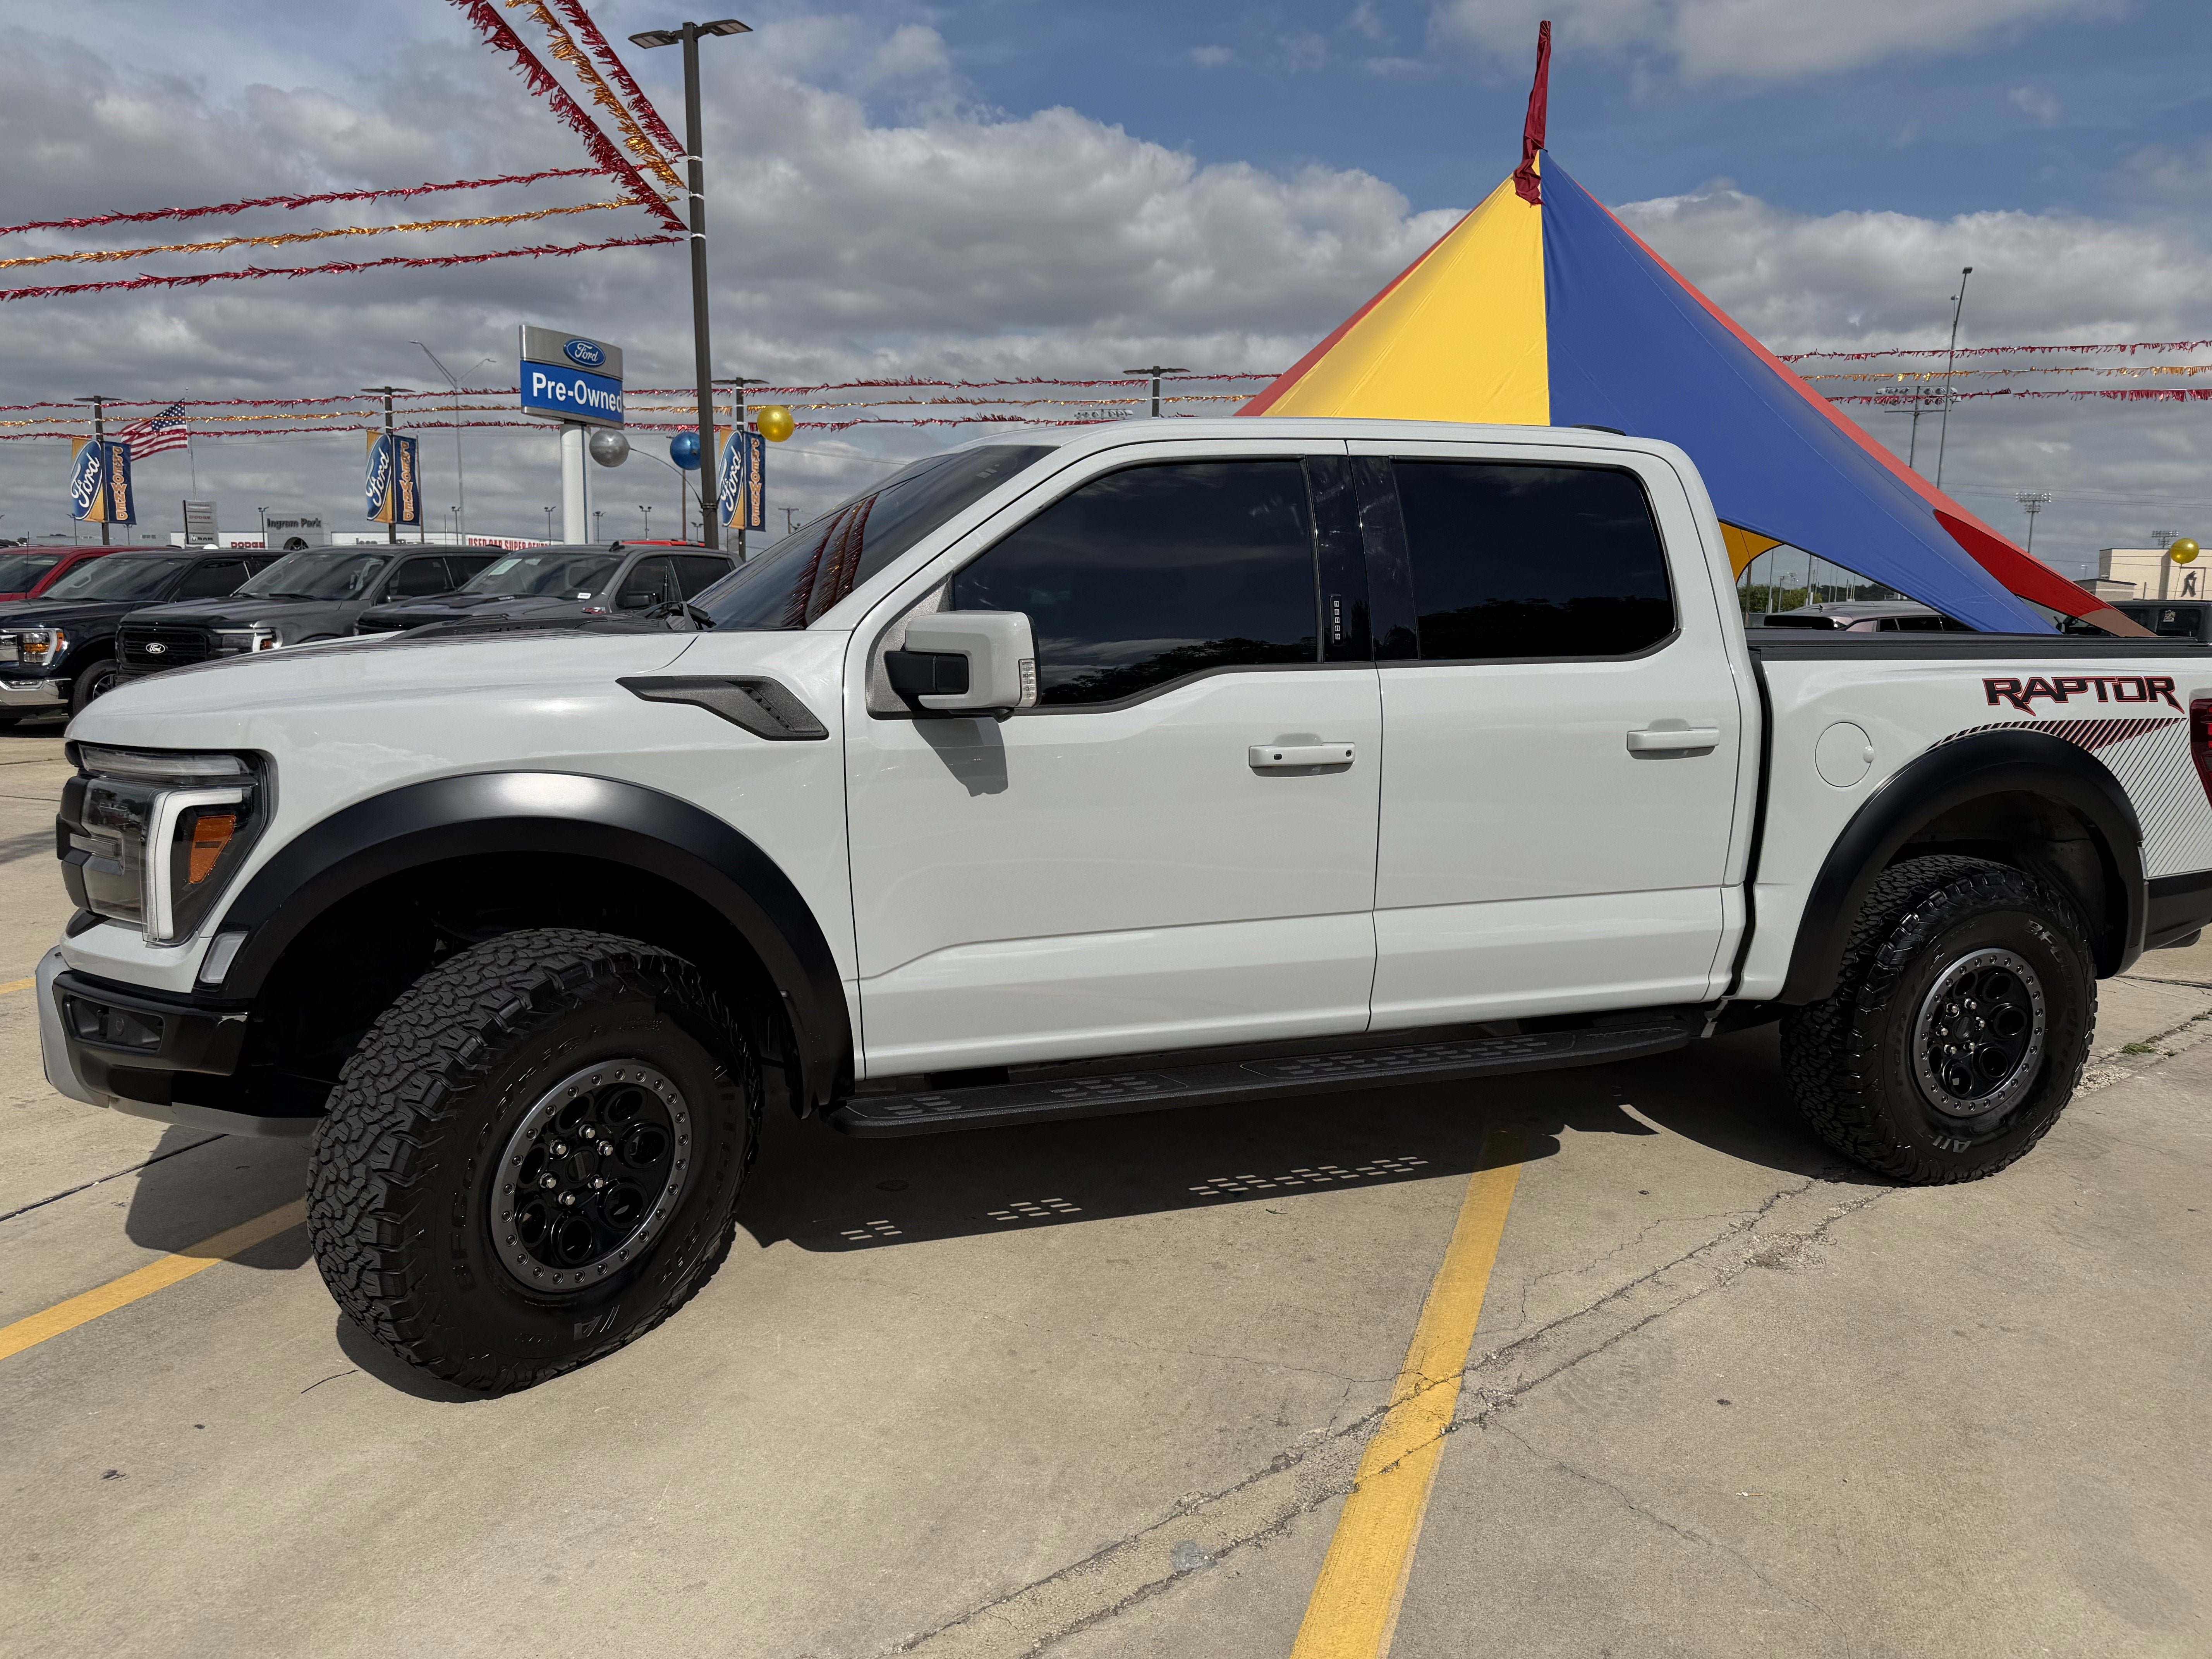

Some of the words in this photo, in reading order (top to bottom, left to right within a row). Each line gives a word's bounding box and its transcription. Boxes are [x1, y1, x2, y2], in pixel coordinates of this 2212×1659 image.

[574, 343, 599, 362] Ford
[532, 372, 622, 413] Pre-Owned
[71, 452, 100, 508] Ford
[366, 447, 390, 507] Ford
[720, 445, 741, 512] Ford
[267, 518, 299, 530] Ingram
[301, 518, 321, 528] Park
[468, 538, 487, 546] USED
[505, 540, 526, 551] SUPER
[1982, 676, 2185, 717] RAPTOR
